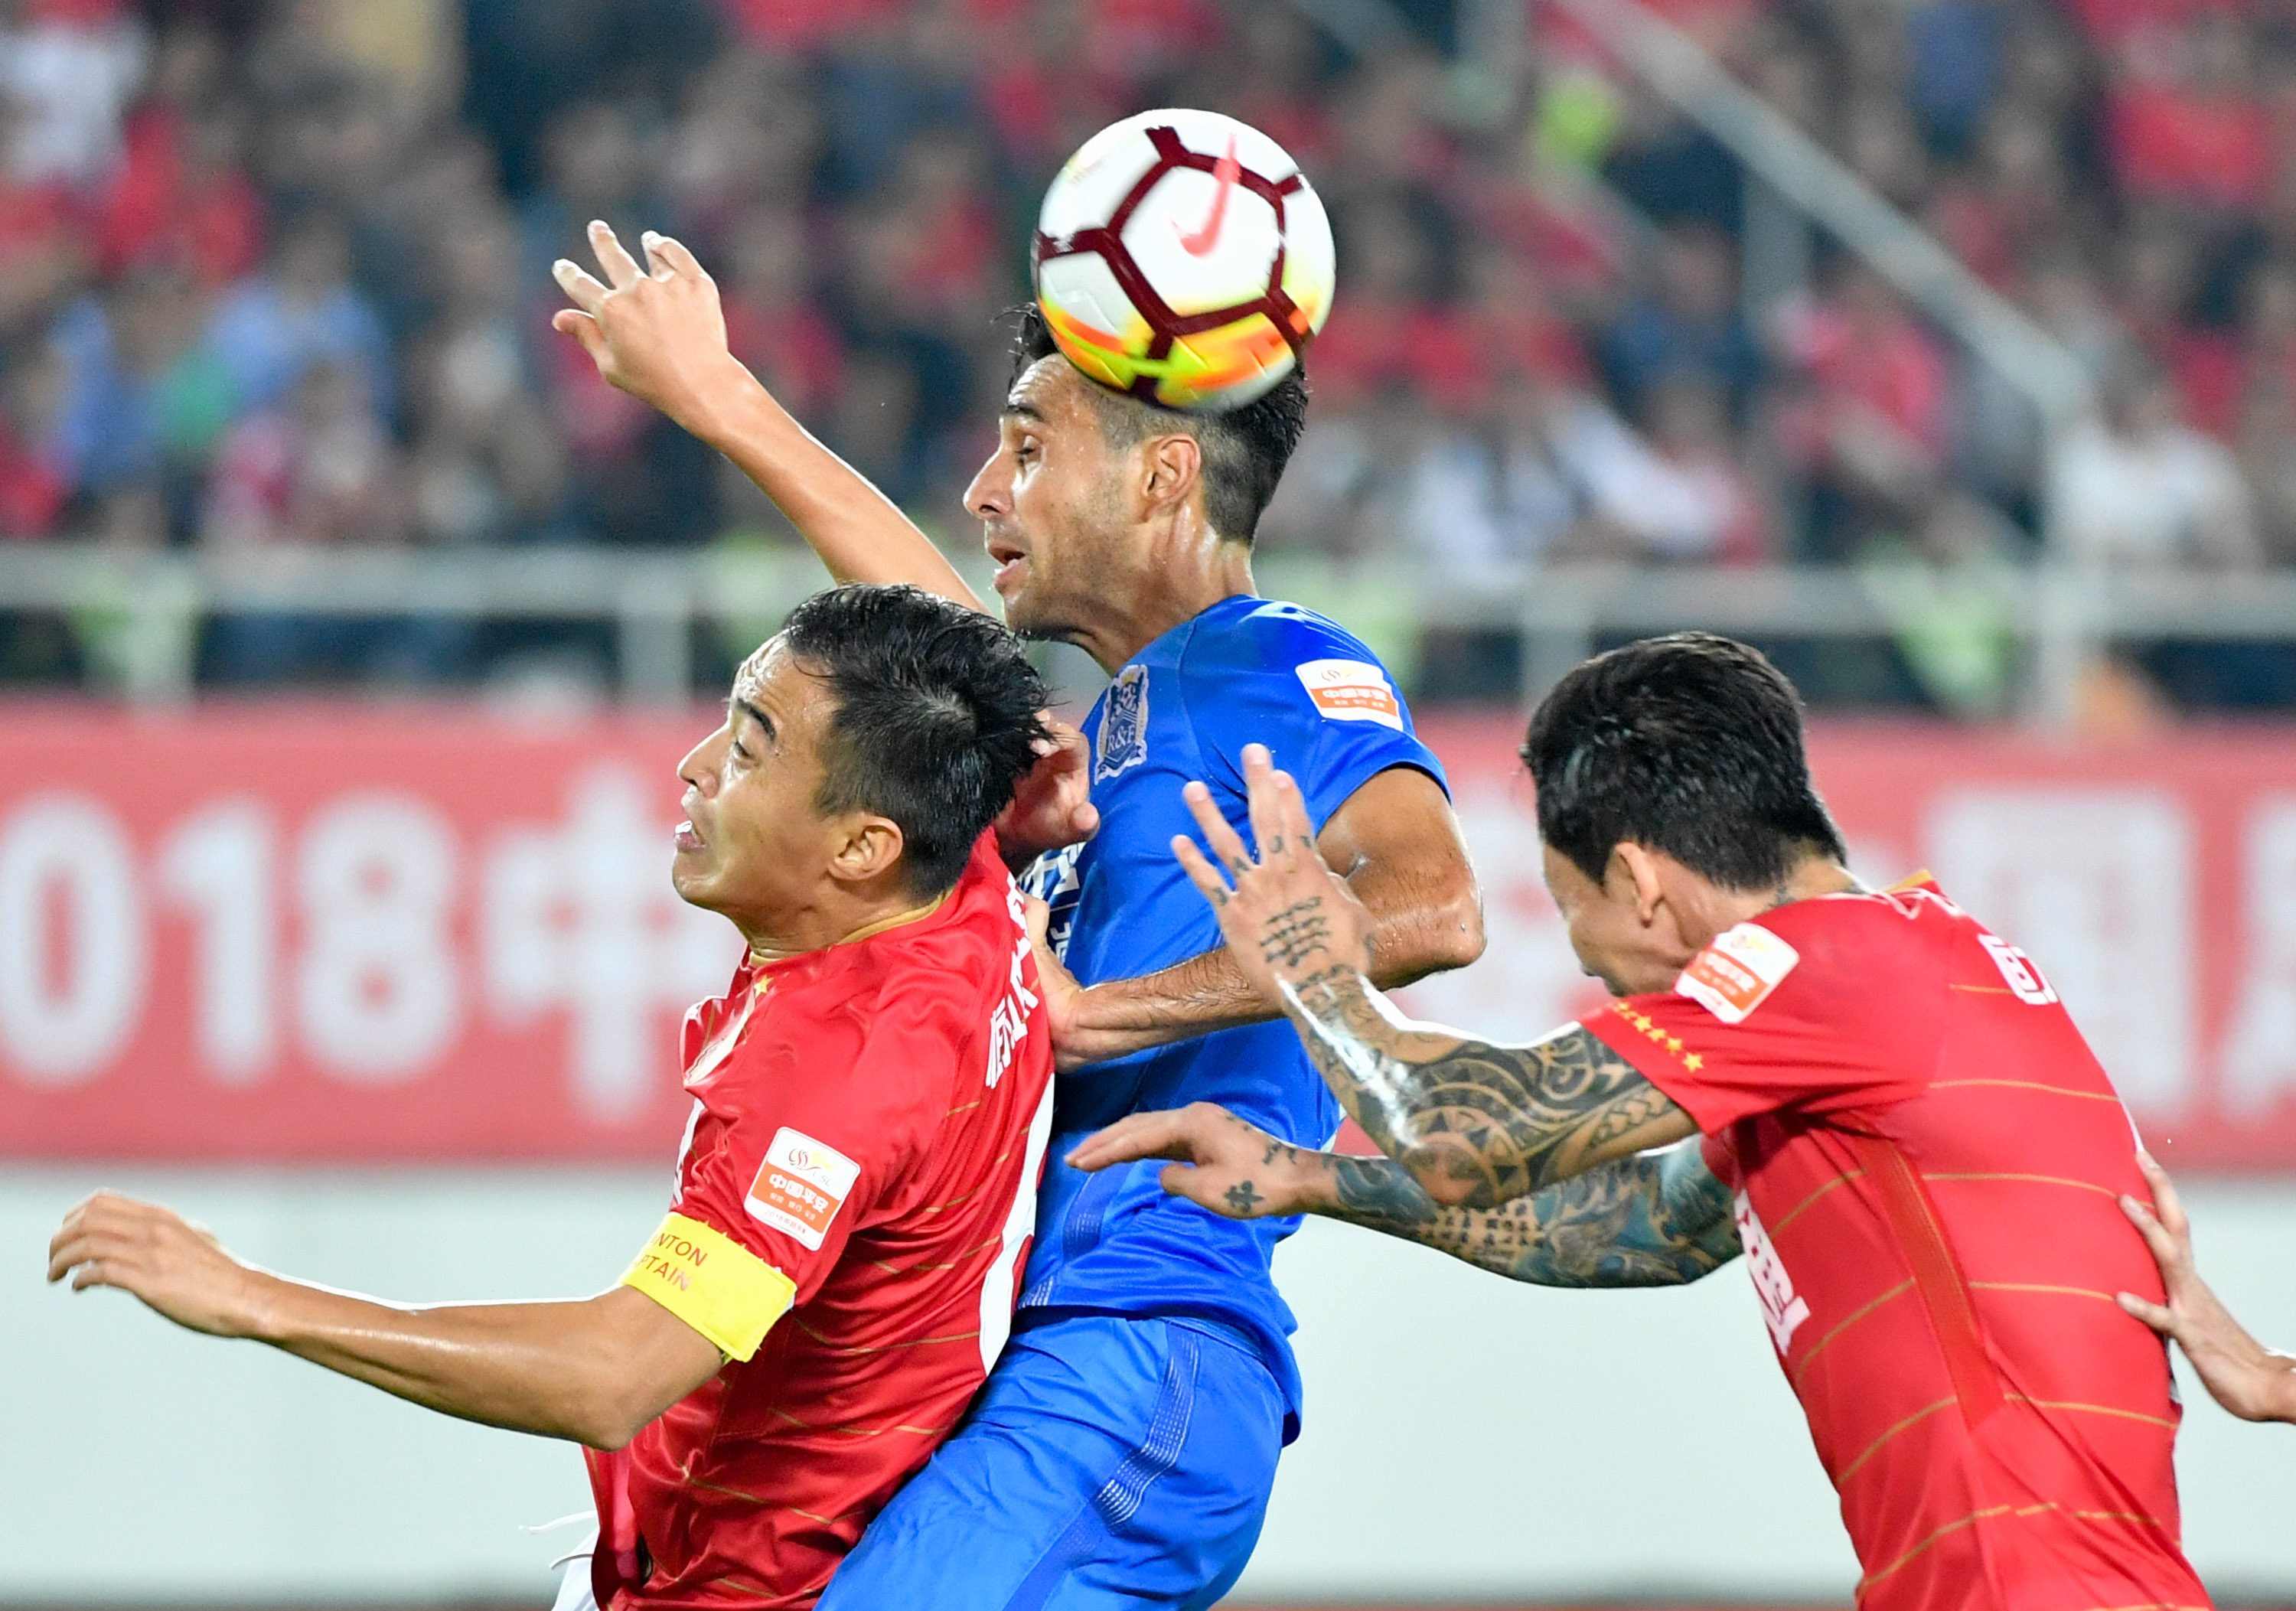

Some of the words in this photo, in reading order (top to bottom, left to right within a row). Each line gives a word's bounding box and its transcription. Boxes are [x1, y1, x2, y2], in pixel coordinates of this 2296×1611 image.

[1106, 723, 1137, 754] R&F
[768, 1173, 829, 1215] 中国平安
